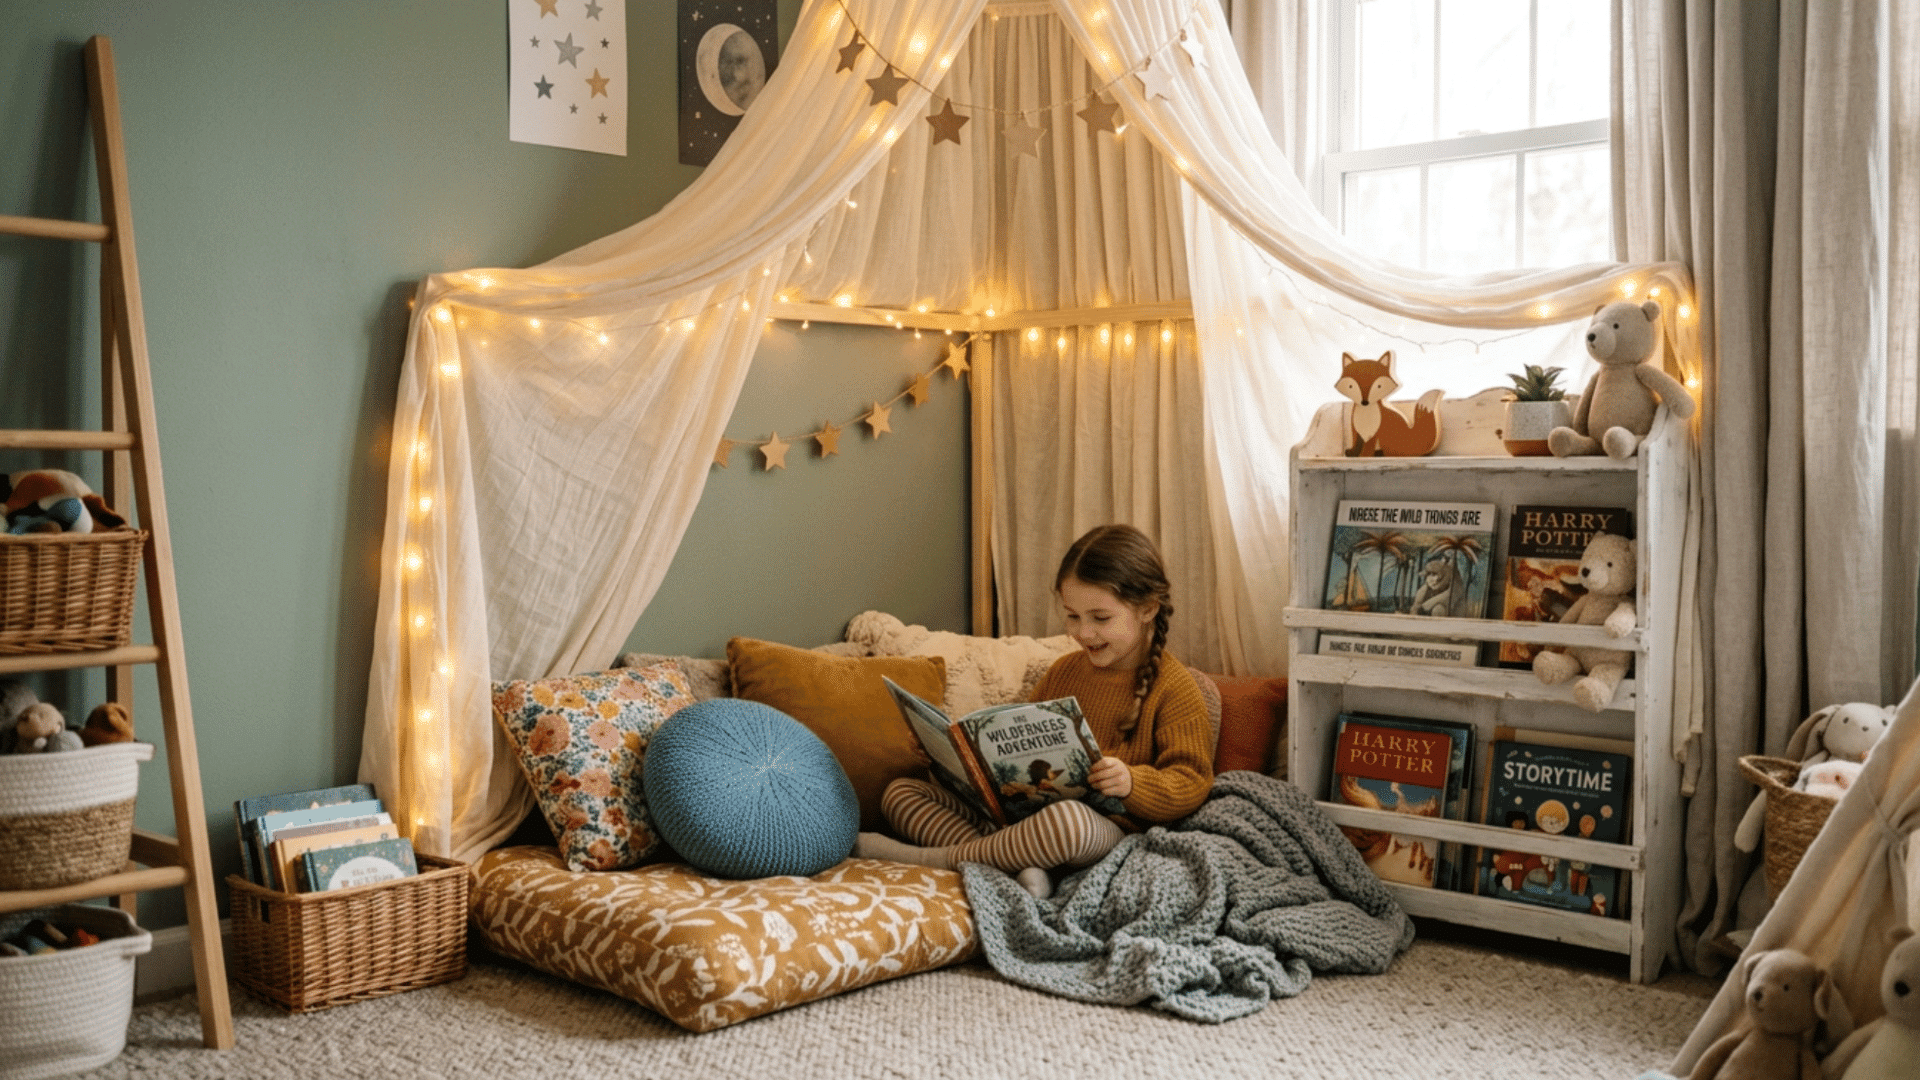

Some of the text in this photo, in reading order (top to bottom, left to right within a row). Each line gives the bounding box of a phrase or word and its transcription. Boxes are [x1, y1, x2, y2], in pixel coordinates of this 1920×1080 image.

[1381, 508, 1399, 523] THE
[1461, 510, 1481, 525] ARE
[1525, 512, 1613, 530] HARRY
[1352, 731, 1436, 755] HARRY
[1350, 748, 1434, 774] POTTER
[1504, 761, 1613, 792] STORYTIME
